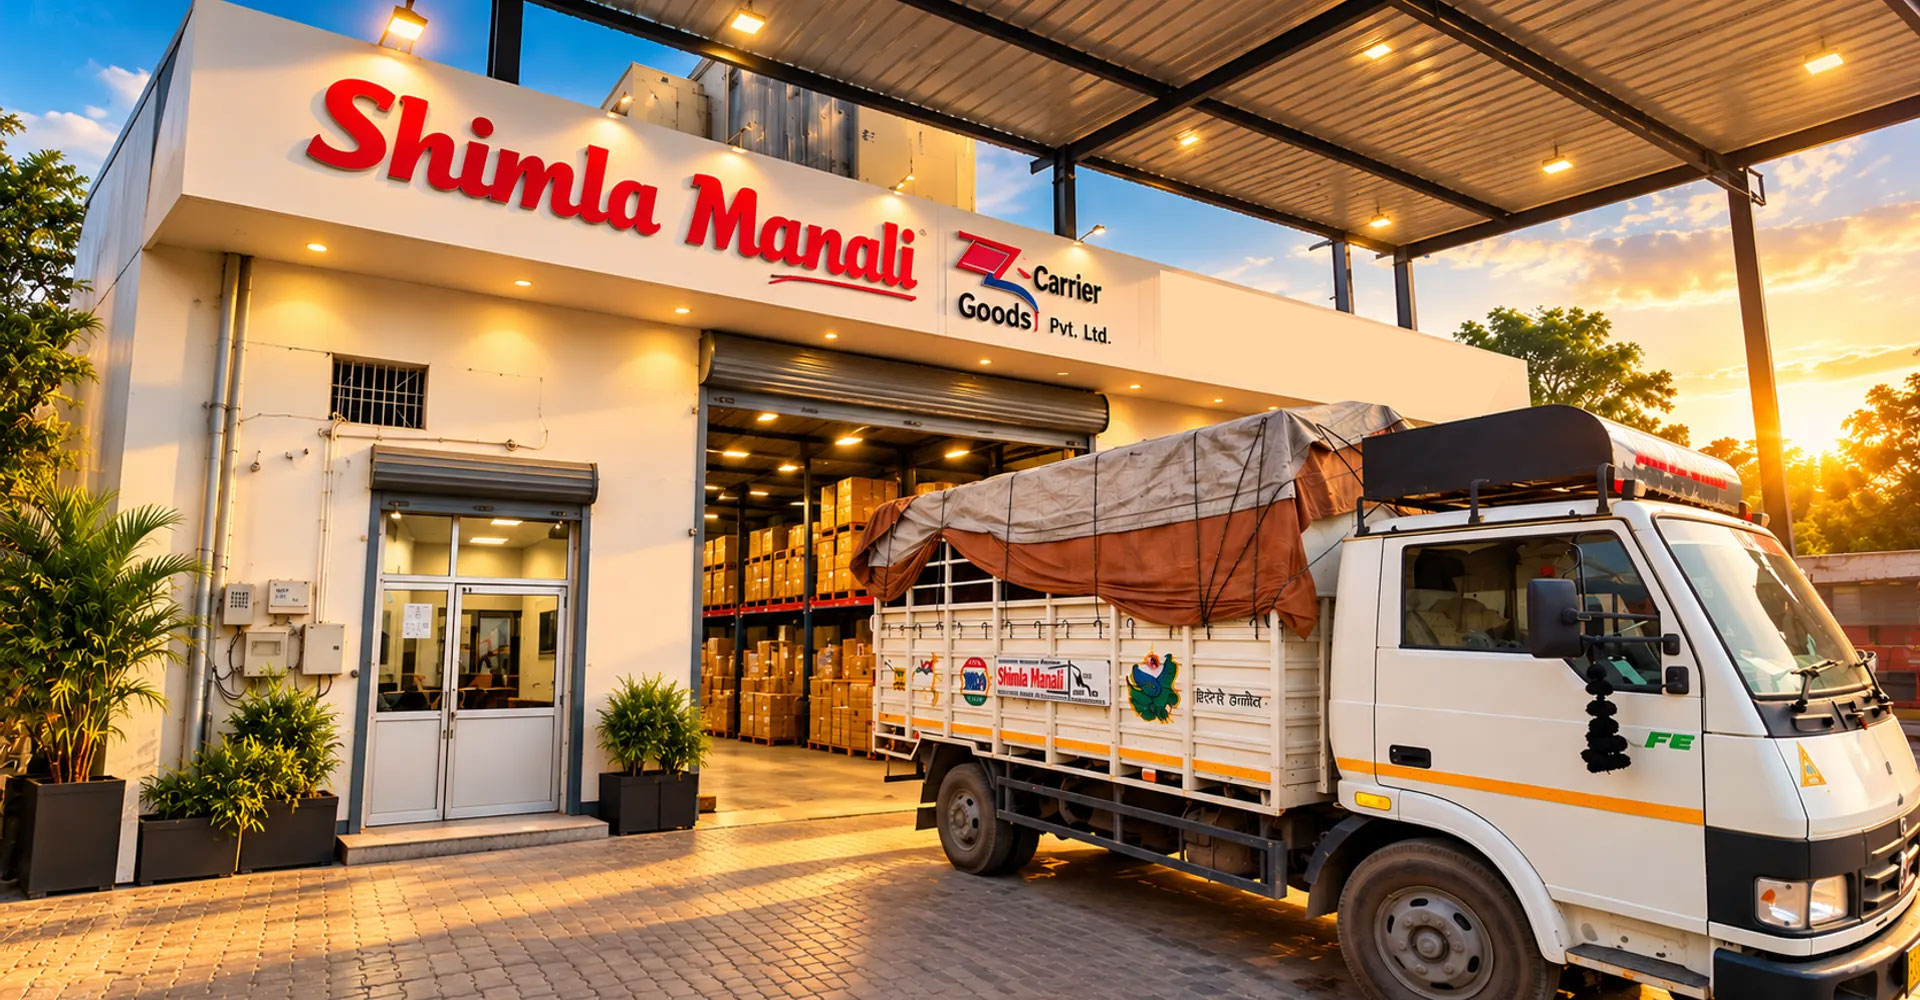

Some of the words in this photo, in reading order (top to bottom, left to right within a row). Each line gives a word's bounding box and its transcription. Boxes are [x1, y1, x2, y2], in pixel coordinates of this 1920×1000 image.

[306, 78, 661, 236] Shimla
[684, 173, 918, 290] Manali
[1033, 265, 1102, 304] Carrier
[958, 292, 1032, 330] Goods
[1050, 317, 1078, 339] Pvt.
[1084, 324, 1112, 345] Ltd.
[997, 666, 1029, 688] Shimla
[1030, 667, 1064, 690] Manali
[1645, 731, 1696, 751] FE
